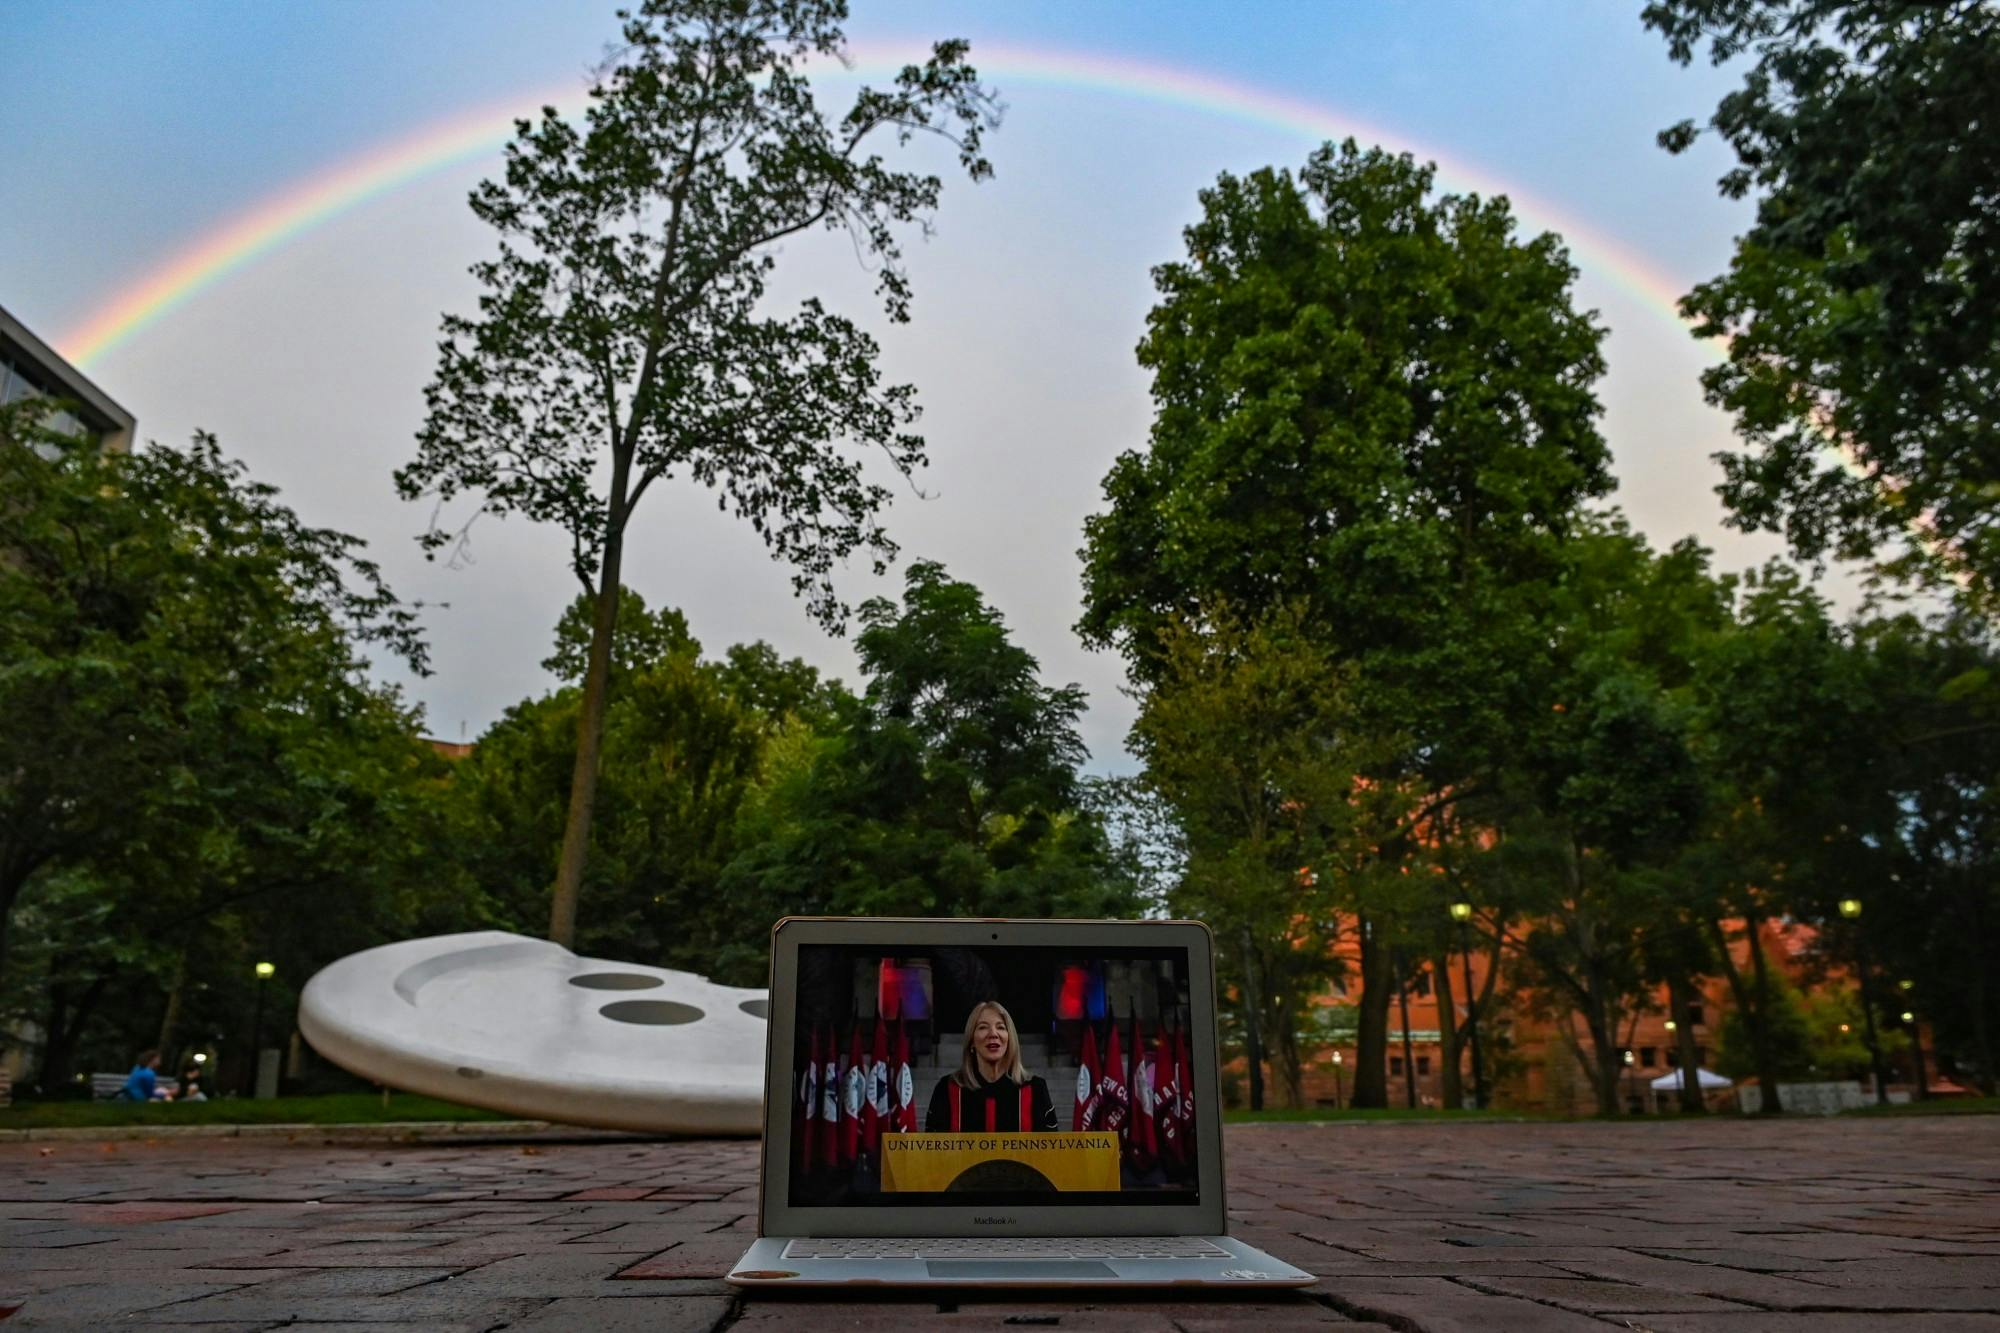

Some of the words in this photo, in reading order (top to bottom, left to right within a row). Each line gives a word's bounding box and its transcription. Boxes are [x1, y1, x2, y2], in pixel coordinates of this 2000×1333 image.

[887, 1139, 975, 1151] UNIVERSITY
[978, 1139, 998, 1151] OF
[1003, 1138, 1111, 1150] PENNSYLVANIA
[974, 1217, 1006, 1225] MacBook
